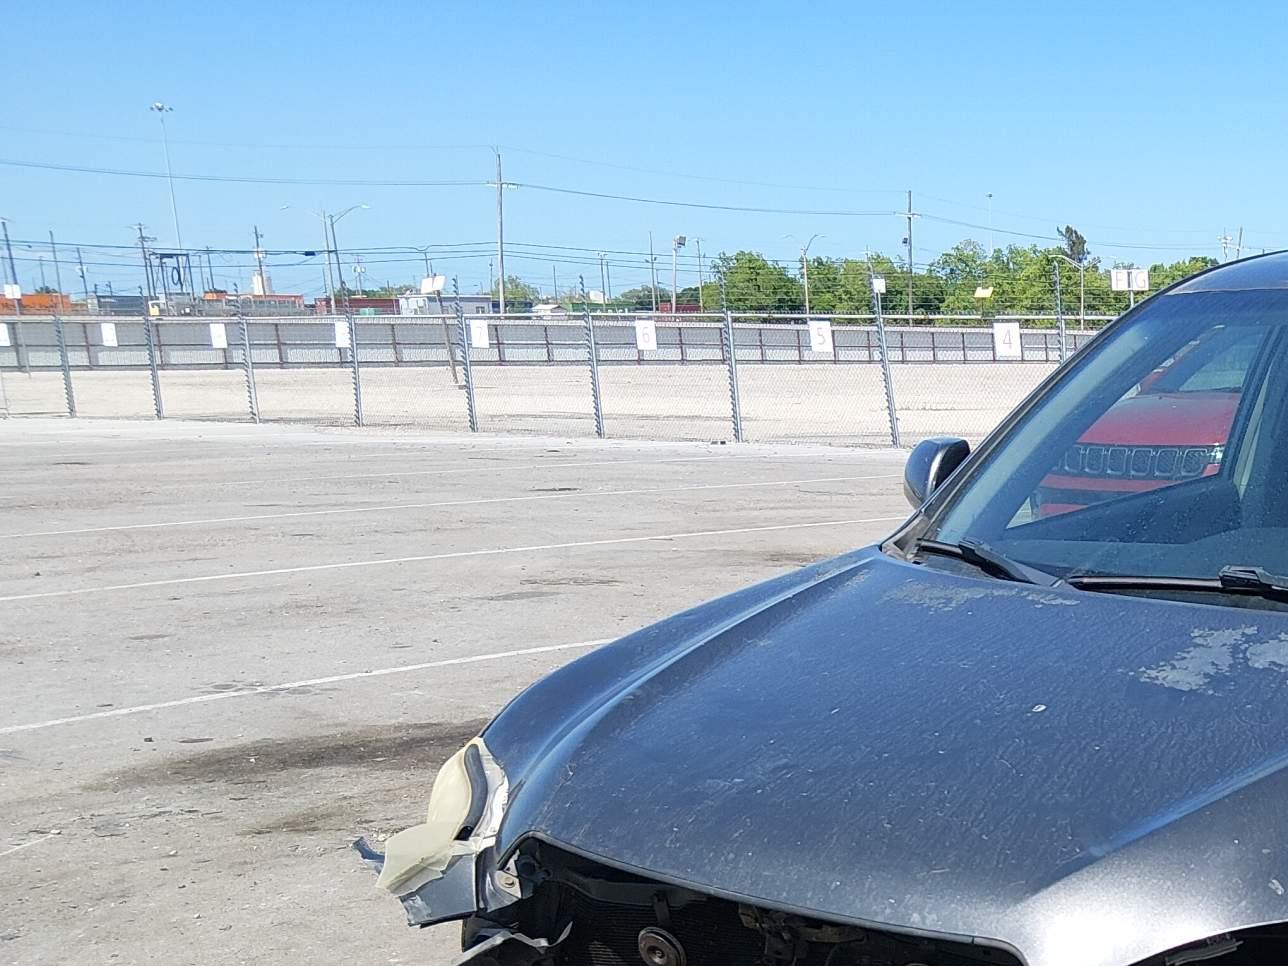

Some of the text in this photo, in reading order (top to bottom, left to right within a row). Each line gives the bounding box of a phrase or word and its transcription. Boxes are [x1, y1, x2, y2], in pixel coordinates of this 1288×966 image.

[641, 326, 650, 344] 6
[816, 327, 826, 346] 5
[1002, 328, 1013, 350] 4
